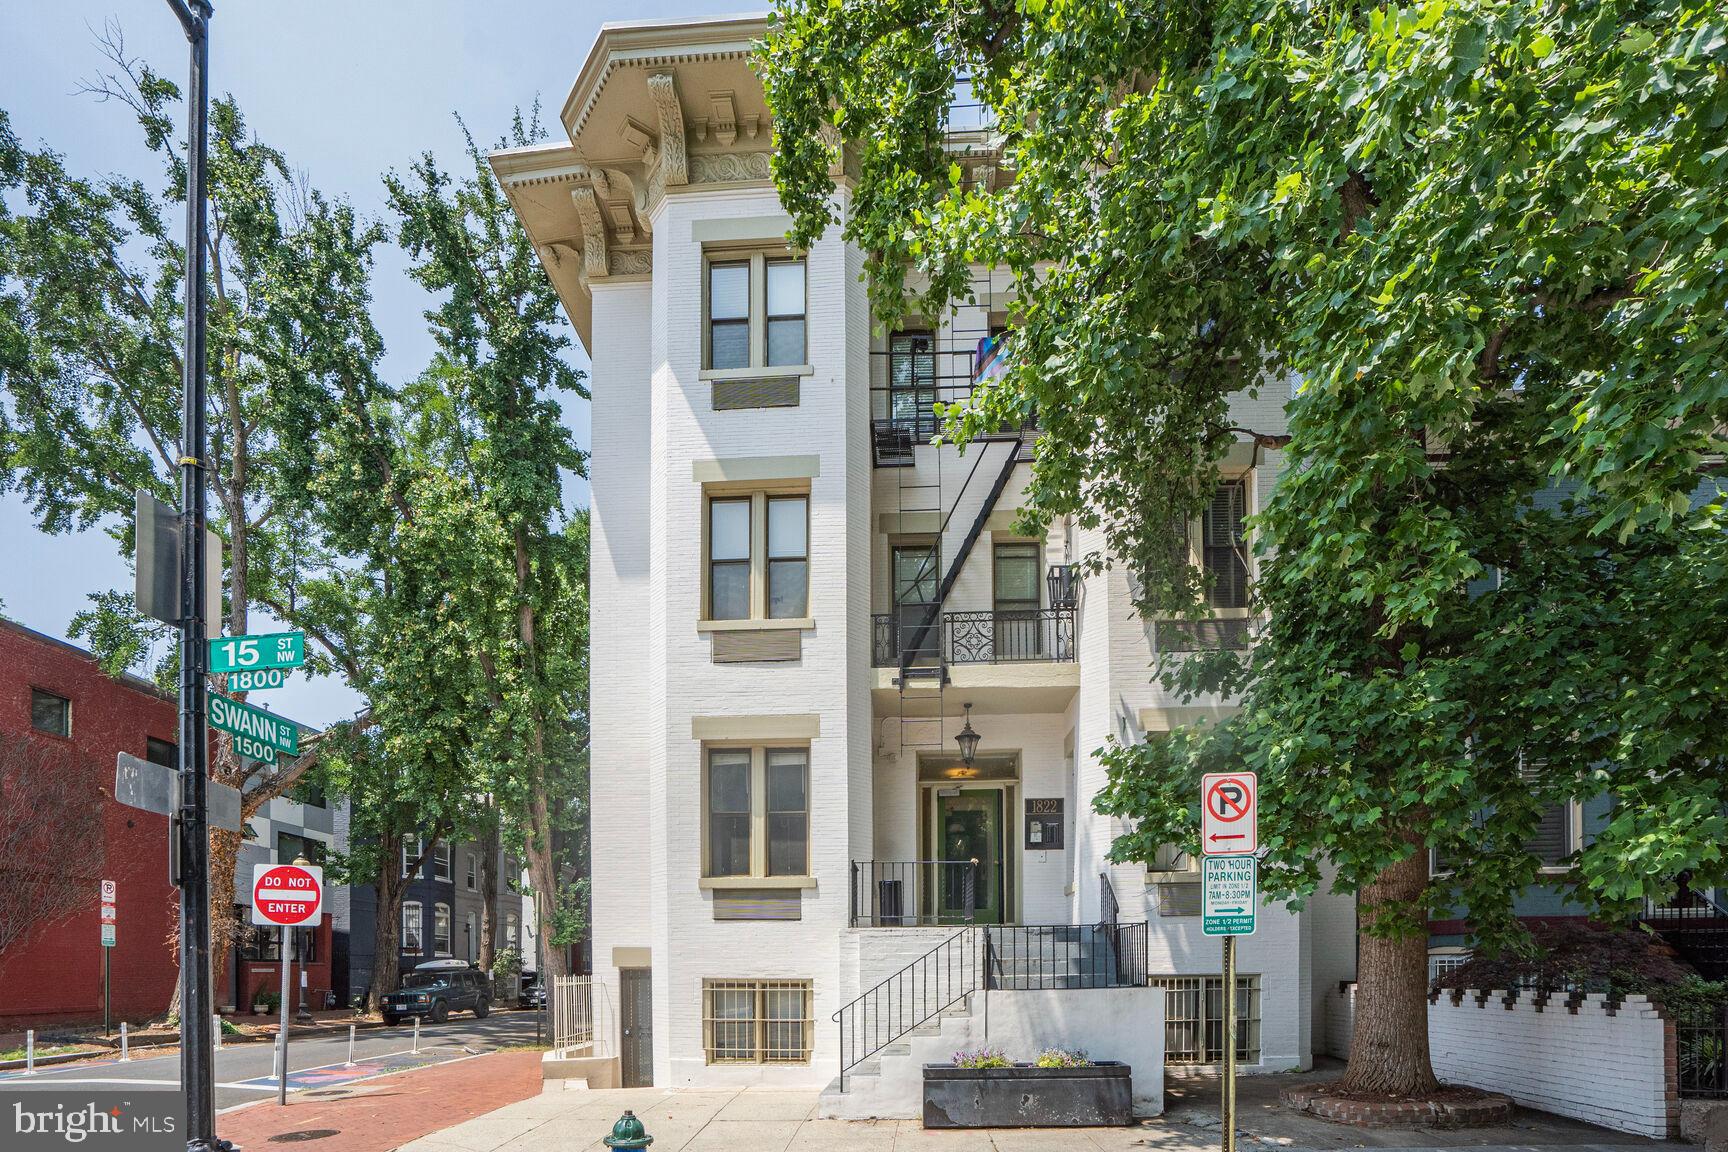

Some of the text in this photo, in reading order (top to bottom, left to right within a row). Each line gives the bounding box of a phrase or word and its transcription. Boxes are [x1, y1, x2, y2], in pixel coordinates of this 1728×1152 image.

[221, 637, 294, 667] 15 ST
[277, 650, 295, 663] NW
[229, 669, 281, 690] 1800
[211, 698, 291, 744] SWANN ST
[234, 735, 274, 762] 1500
[279, 736, 292, 749] NW
[1032, 799, 1057, 813] 1822
[1208, 859, 1252, 870] TWO HOUR
[264, 876, 312, 888] DO NOT
[1208, 871, 1251, 882] PARKING
[268, 903, 306, 914] ENTER
